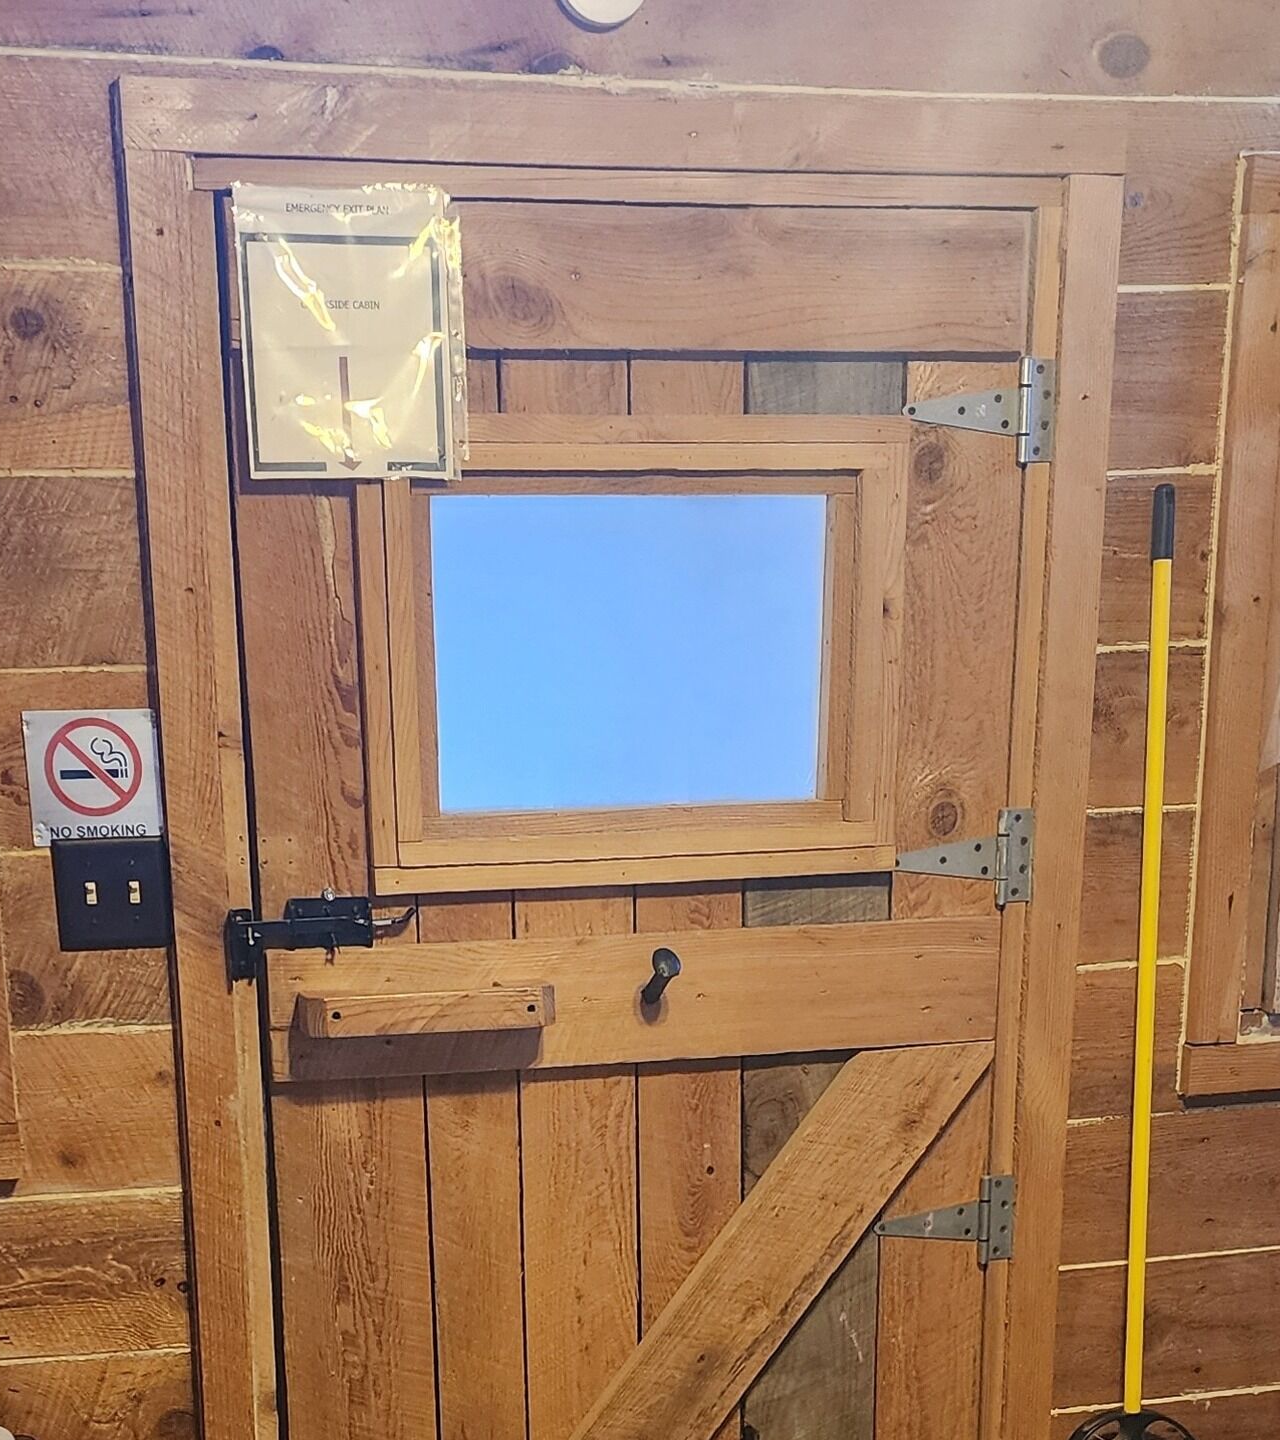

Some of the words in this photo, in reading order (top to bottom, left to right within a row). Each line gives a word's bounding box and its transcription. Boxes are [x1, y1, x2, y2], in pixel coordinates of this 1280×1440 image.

[352, 300, 380, 310] CABIN
[50, 826, 72, 838] NO
[76, 823, 147, 838] SMOKING
